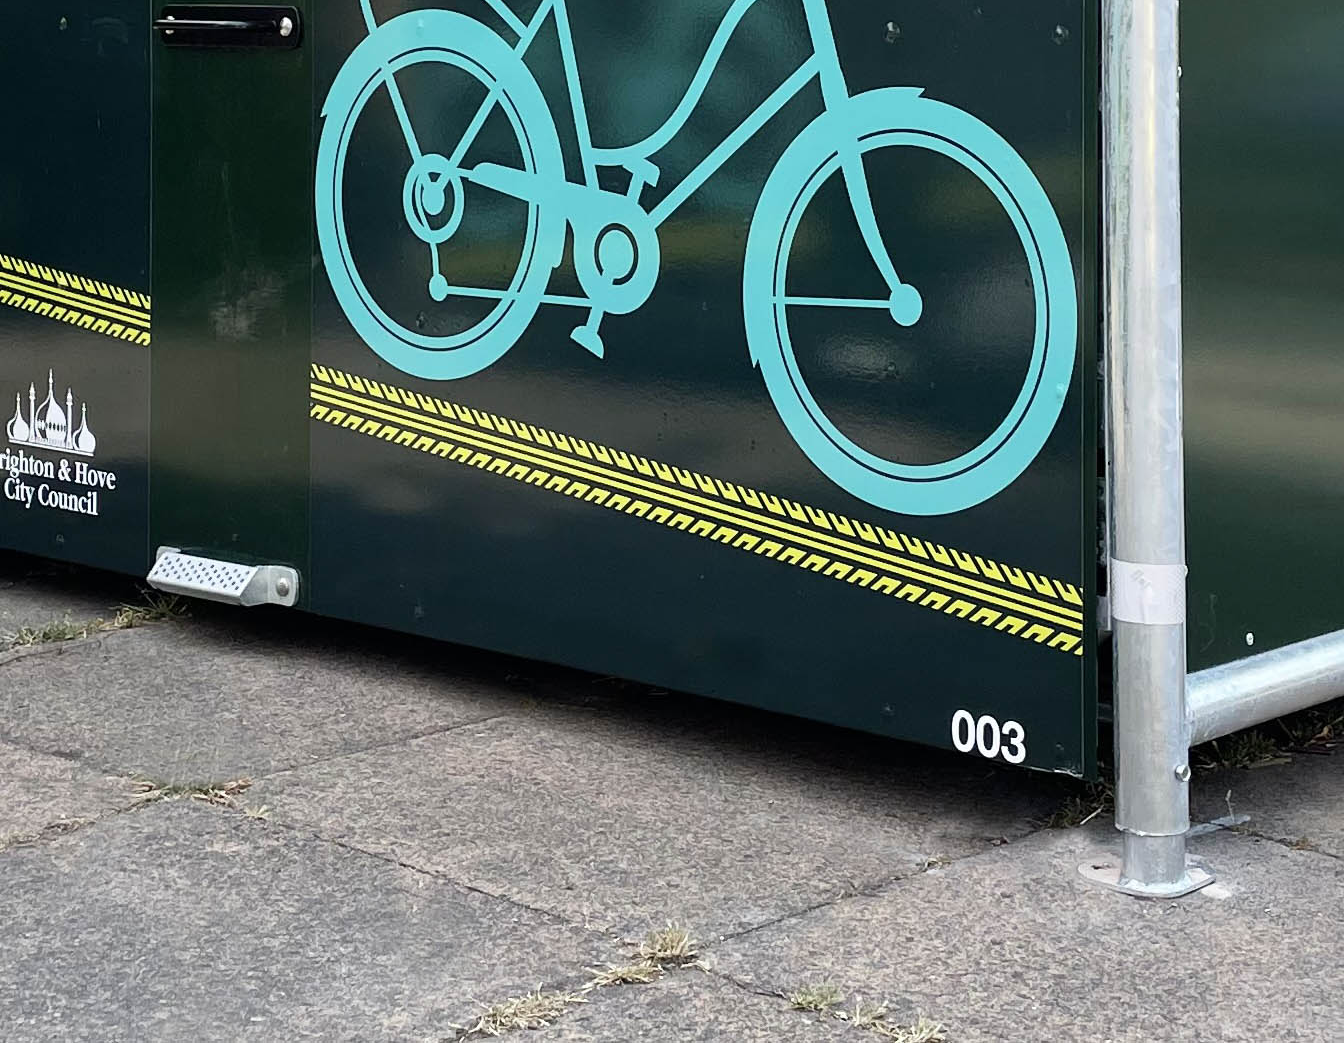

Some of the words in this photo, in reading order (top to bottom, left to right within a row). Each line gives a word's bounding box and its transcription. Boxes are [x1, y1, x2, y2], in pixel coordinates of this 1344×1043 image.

[57, 458, 72, 482] &
[74, 461, 117, 490] Hove
[3, 477, 35, 509] City
[37, 483, 99, 516] Council
[951, 709, 1027, 764] 003
